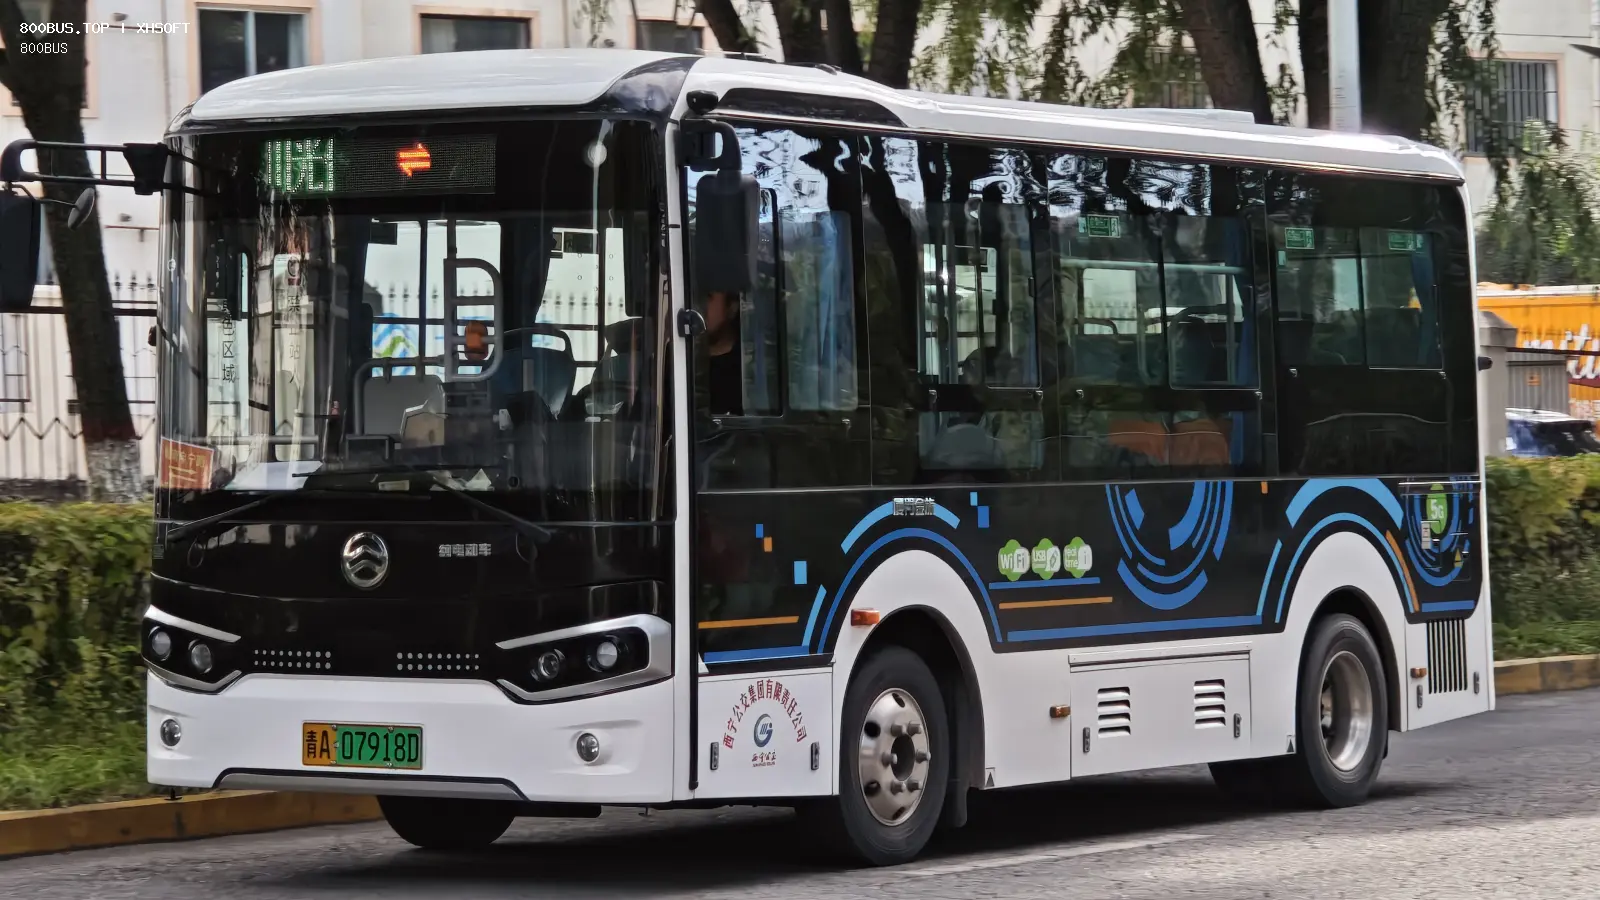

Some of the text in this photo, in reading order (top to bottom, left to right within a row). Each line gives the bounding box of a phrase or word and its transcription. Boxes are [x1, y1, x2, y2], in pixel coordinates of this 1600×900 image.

[1430, 499, 1445, 519] 5G
[723, 679, 808, 750] 西宁公交集团有限责任公司
[305, 730, 419, 762] 青A 07918D
